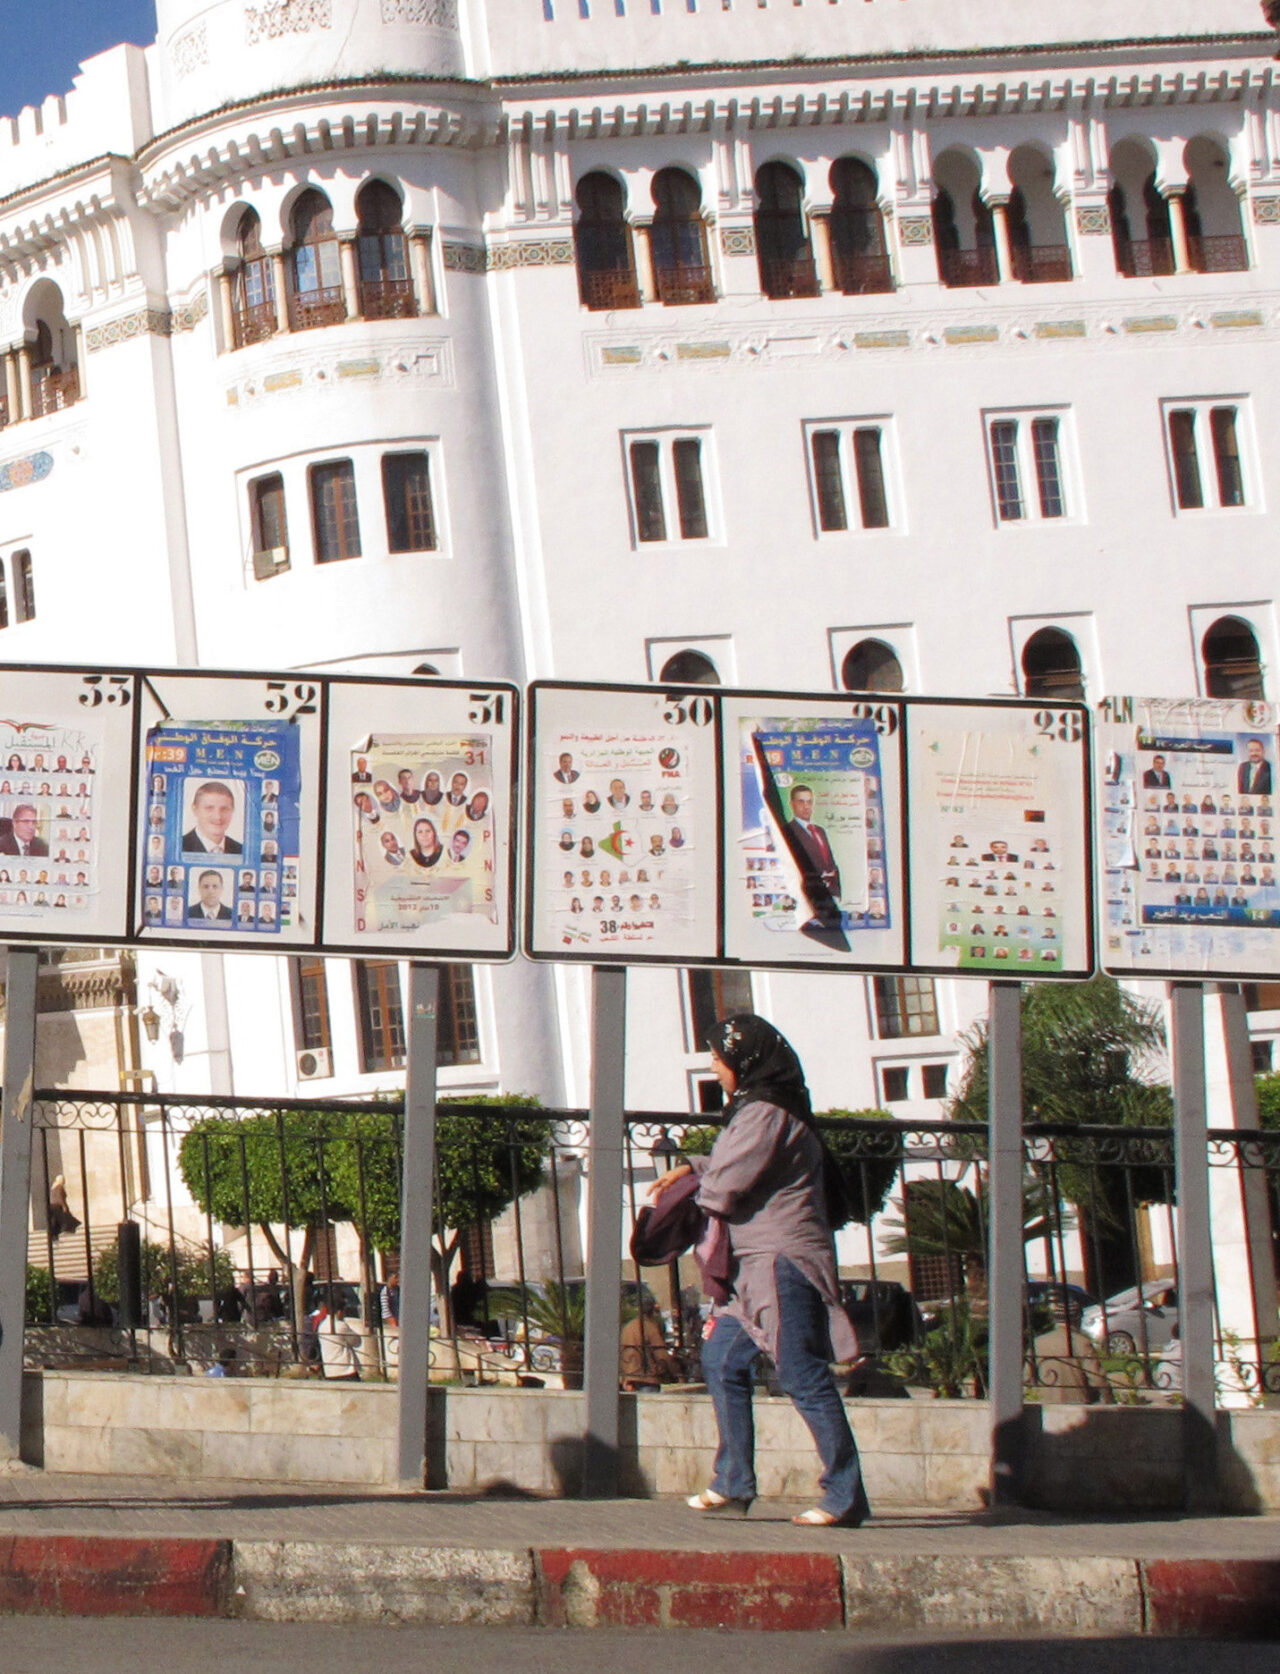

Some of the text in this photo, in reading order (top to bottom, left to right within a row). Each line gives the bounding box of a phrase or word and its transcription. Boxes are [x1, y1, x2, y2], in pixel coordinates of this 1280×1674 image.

[78, 675, 131, 707] 33
[264, 682, 317, 715] 32
[468, 693, 504, 725] 31
[663, 694, 713, 727] 30
[154, 732, 278, 748] حركة الوفاق الوطني
[1033, 710, 1082, 743] 28
[464, 750, 486, 766] 31
[600, 920, 617, 934] 38
